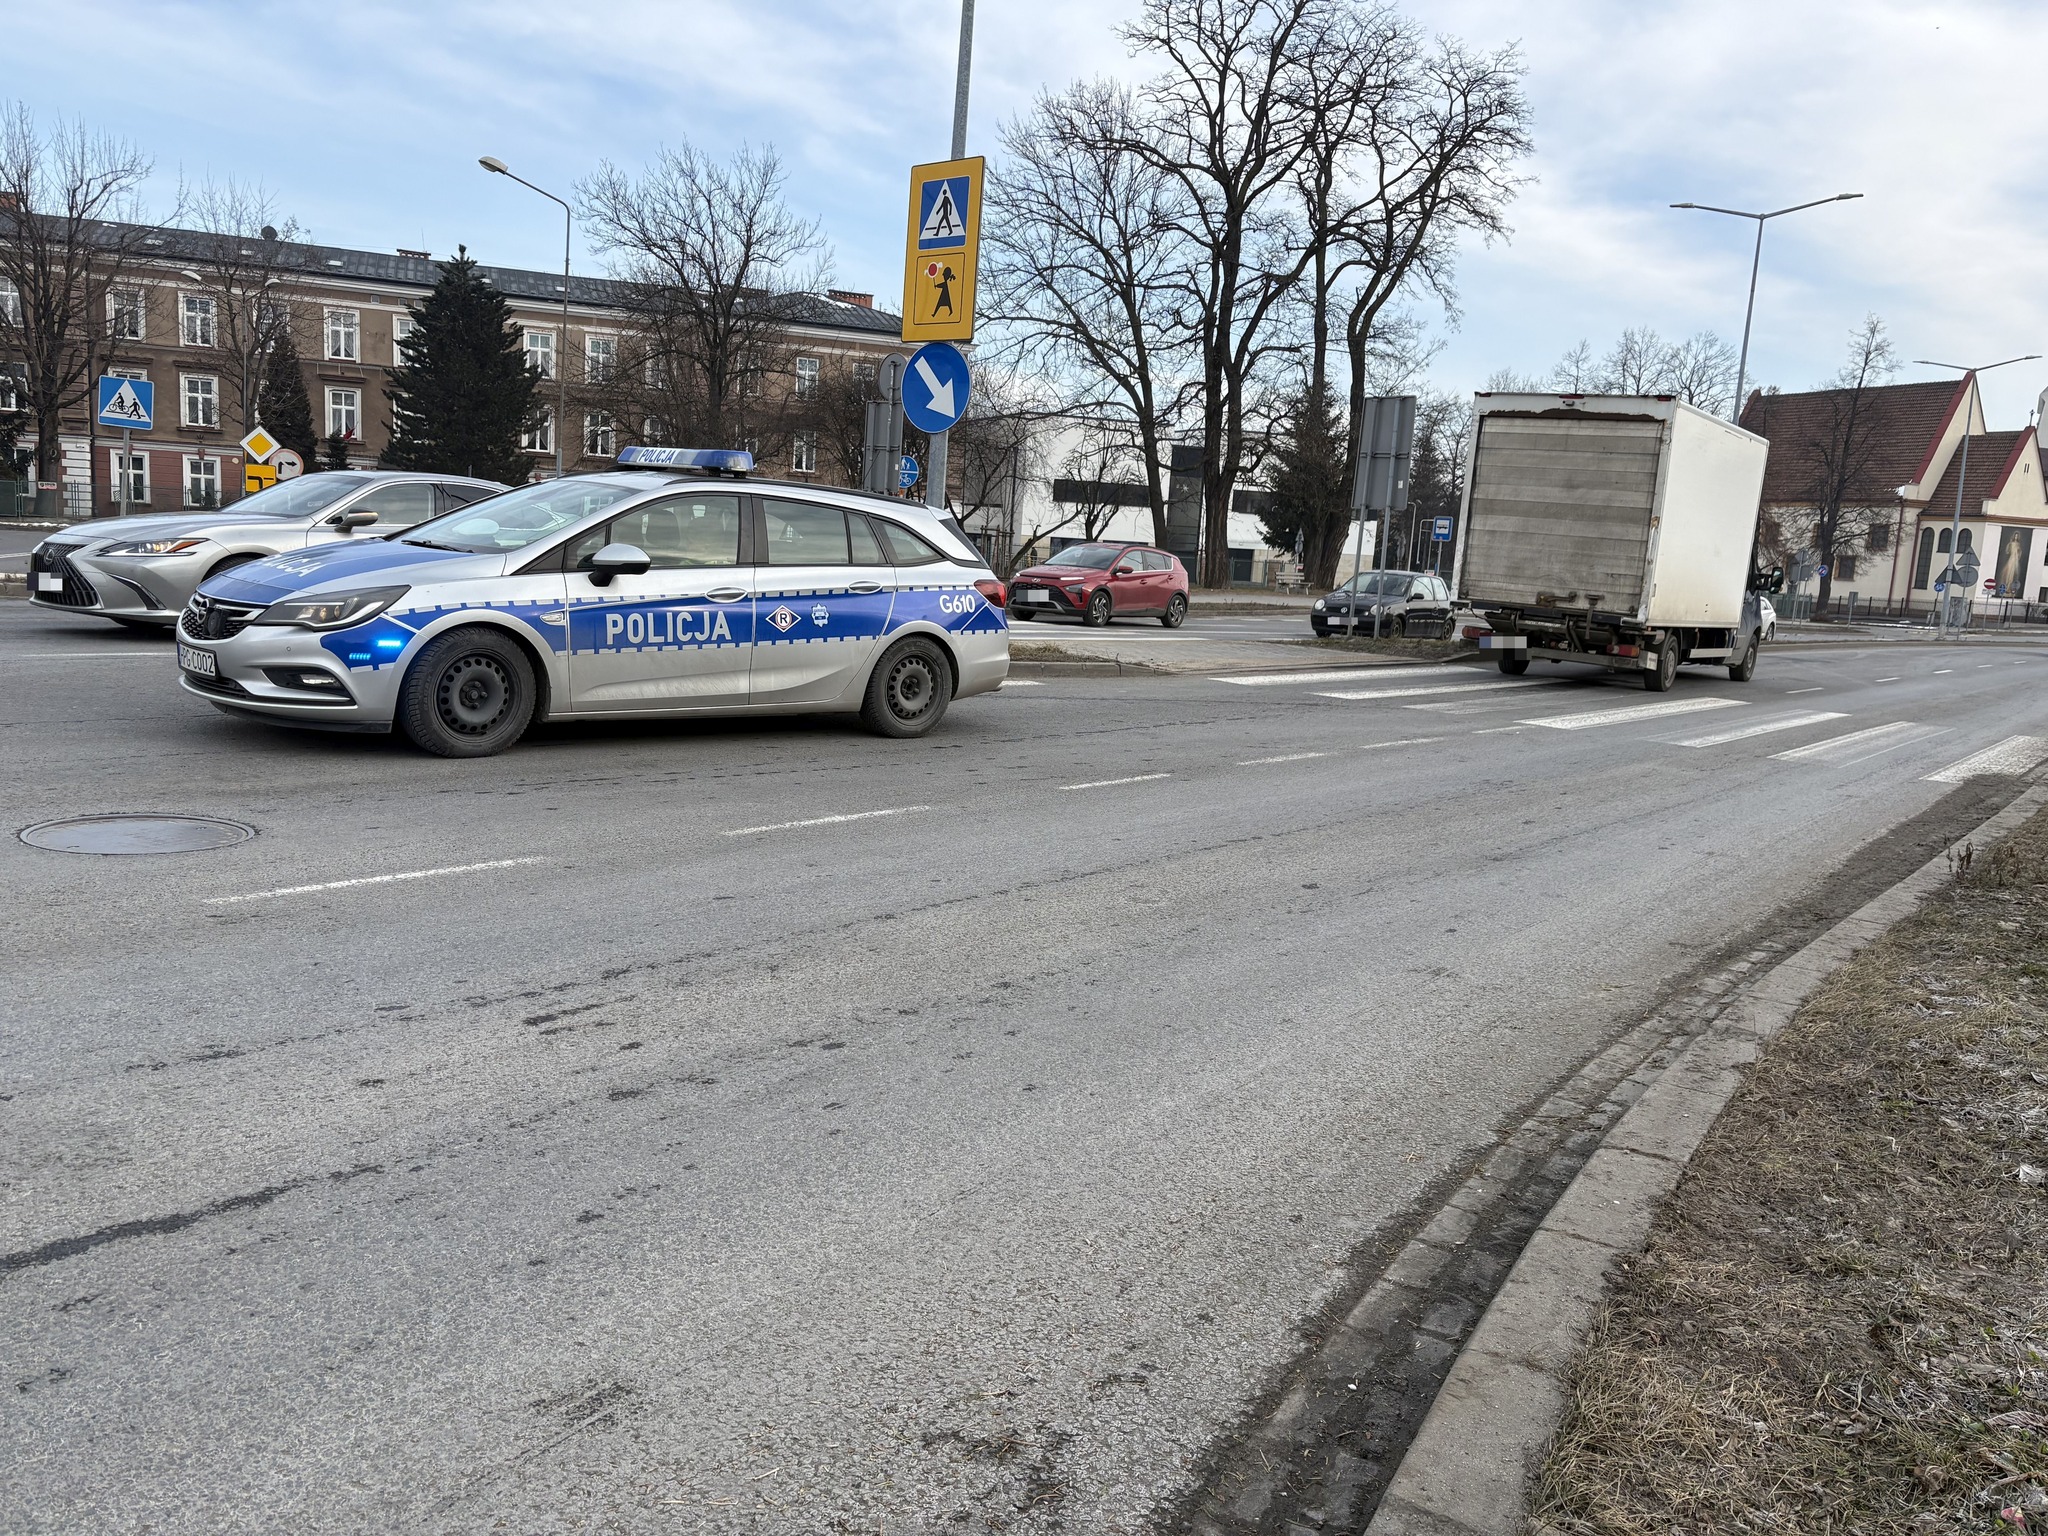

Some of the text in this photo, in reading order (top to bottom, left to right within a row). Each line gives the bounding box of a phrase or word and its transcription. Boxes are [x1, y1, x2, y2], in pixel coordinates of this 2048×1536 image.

[639, 448, 677, 464] POLICJA
[939, 594, 976, 614] G610
[605, 610, 732, 645] POLICJA
[779, 612, 788, 624] R
[192, 651, 214, 674] C002
